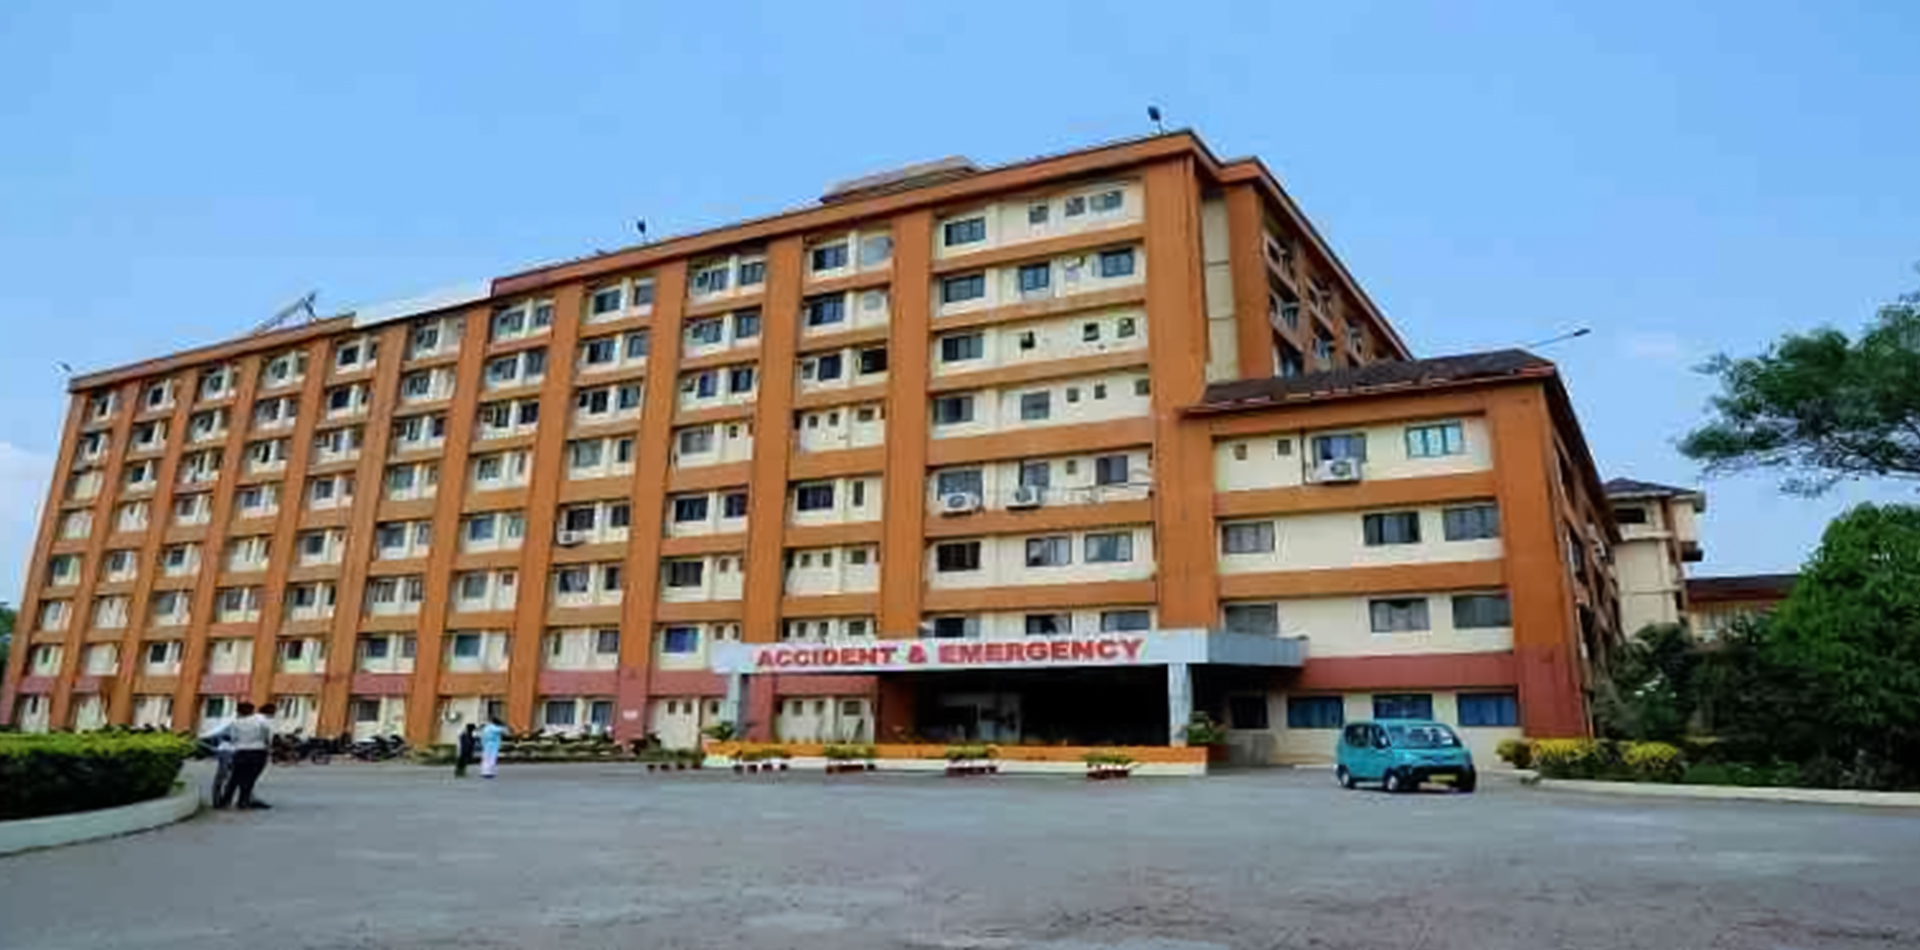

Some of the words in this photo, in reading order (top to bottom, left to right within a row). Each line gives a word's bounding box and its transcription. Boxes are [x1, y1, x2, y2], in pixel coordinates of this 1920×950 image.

[757, 647, 898, 666] ACCIDENT
[908, 644, 927, 664] &
[938, 638, 1143, 663] EMERGENCY
